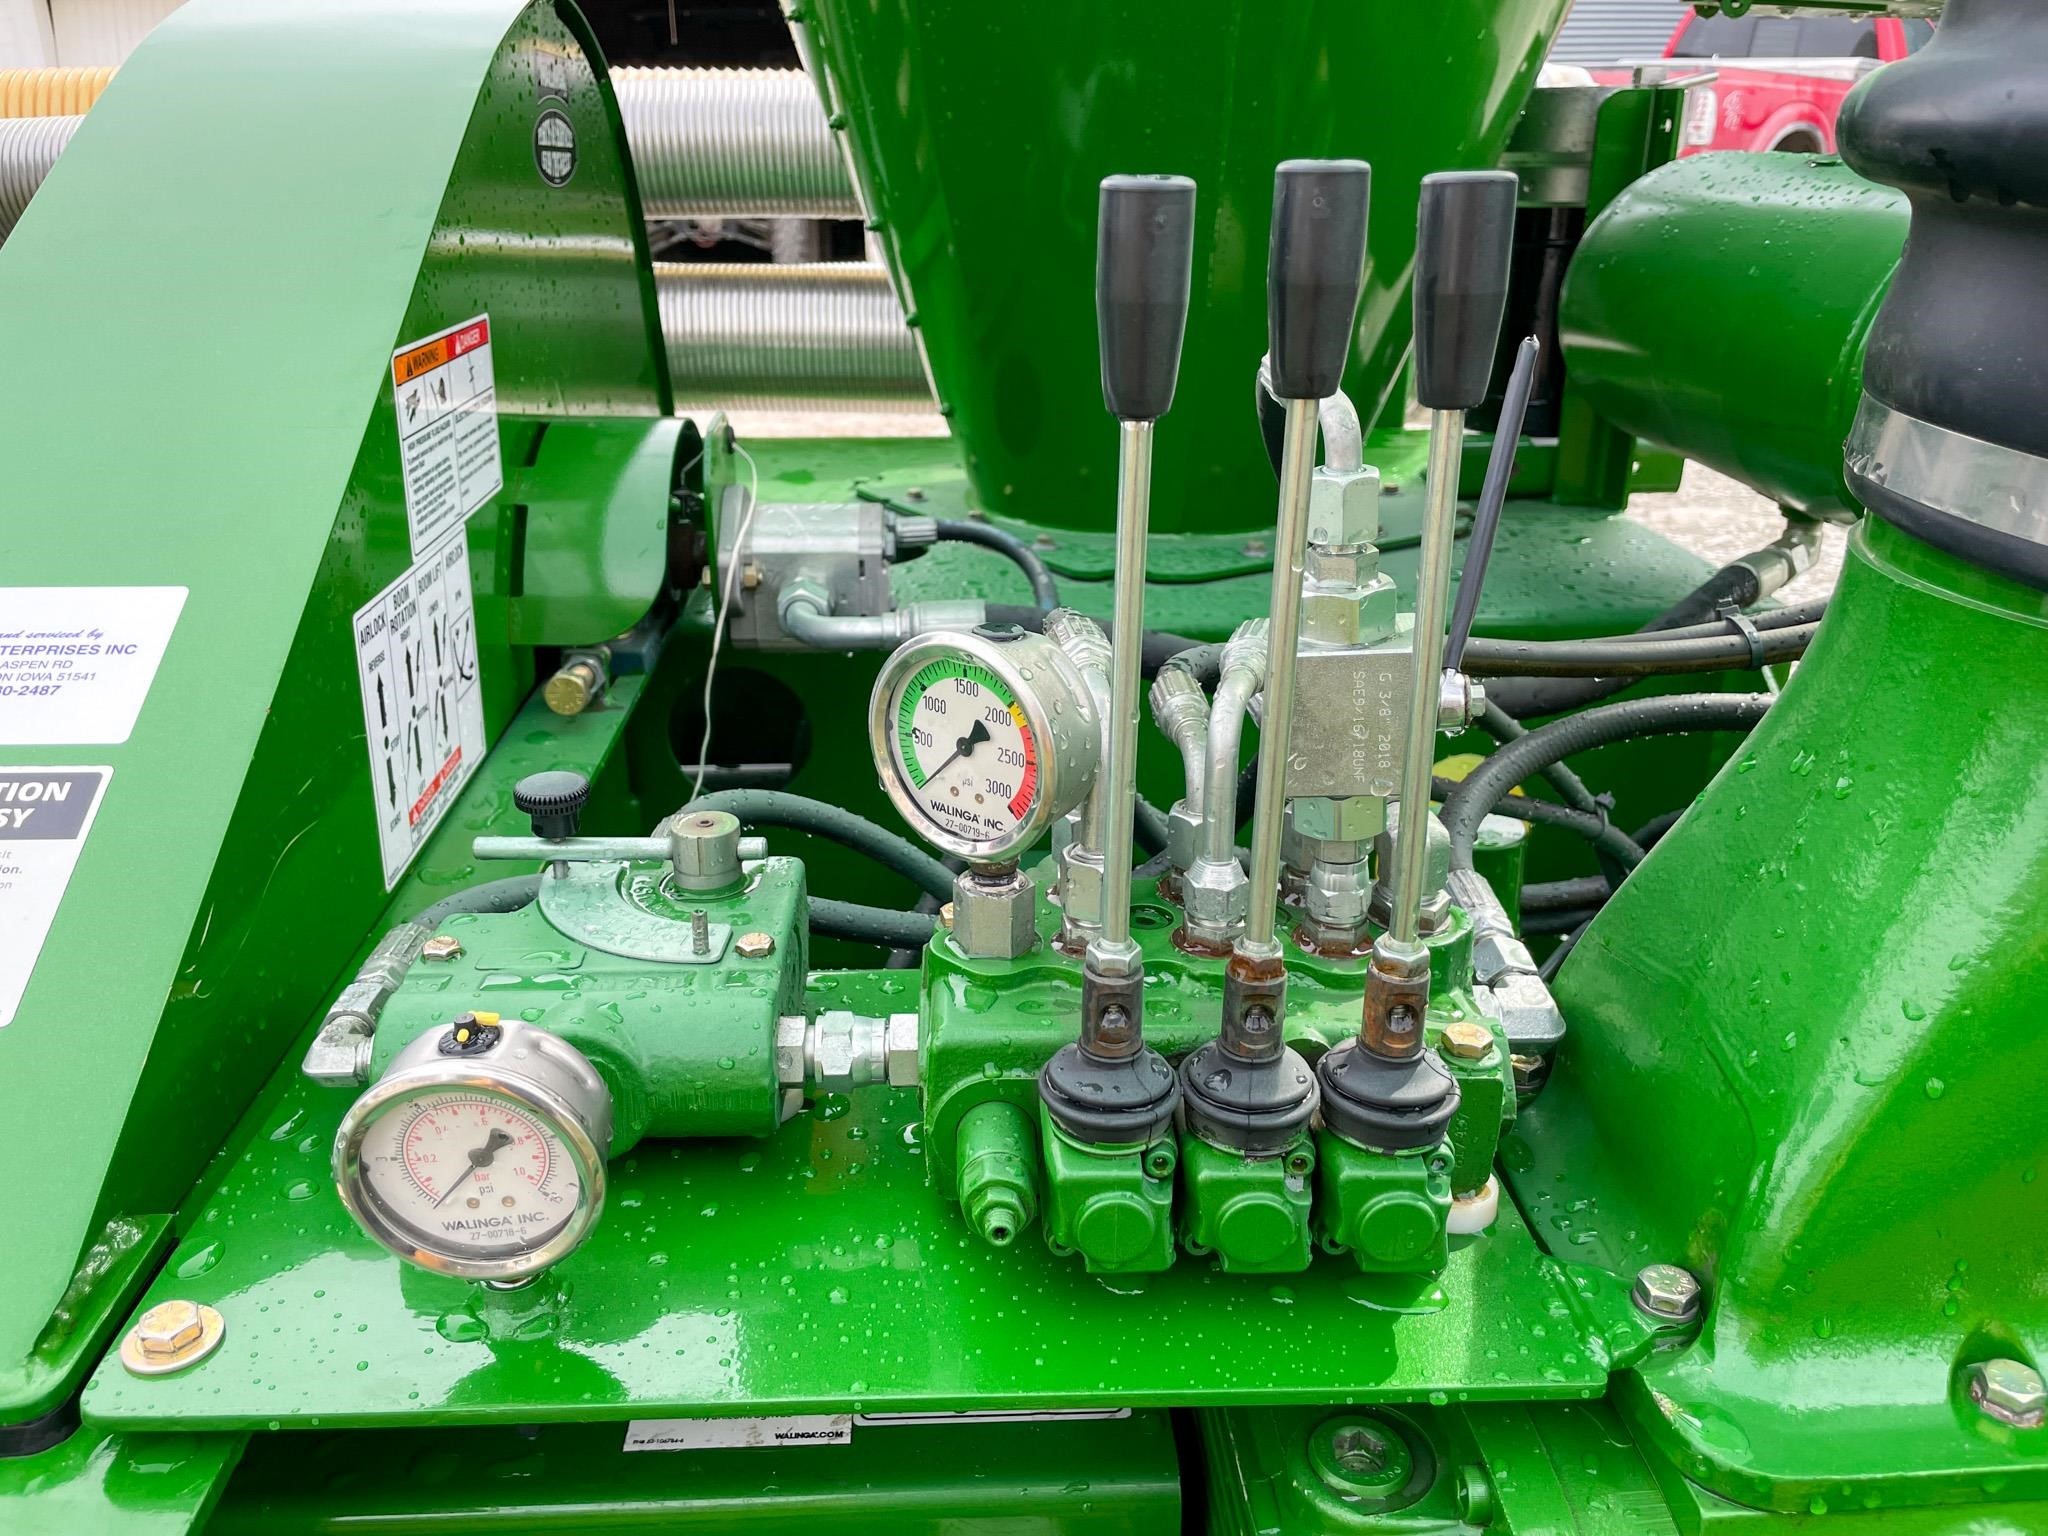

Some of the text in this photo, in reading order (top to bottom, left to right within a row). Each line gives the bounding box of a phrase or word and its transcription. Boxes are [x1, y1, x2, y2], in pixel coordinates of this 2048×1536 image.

[392, 582, 410, 612] BOOM
[389, 598, 417, 637] ROTATION
[25, 628, 86, 640] serviced
[86, 627, 105, 641] by
[358, 610, 386, 648] AIRLOCK
[104, 643, 138, 656] INC
[0, 659, 74, 670] ASPEN RD
[15, 671, 53, 682] IOWA
[56, 671, 97, 682] 51541
[1380, 673, 1392, 682] G
[954, 677, 979, 698] 1500
[922, 695, 947, 715] 1000
[984, 706, 1012, 727] 2000
[914, 727, 933, 748] 500
[997, 747, 1025, 768] 2500
[1378, 734, 1391, 768] 2018
[985, 778, 1012, 800] 3000
[930, 800, 1007, 833] WALINGA INC.
[474, 1172, 490, 1182] bar
[442, 1212, 550, 1231] WALINGA INC.
[774, 1430, 845, 1440] WALINGA.COM
